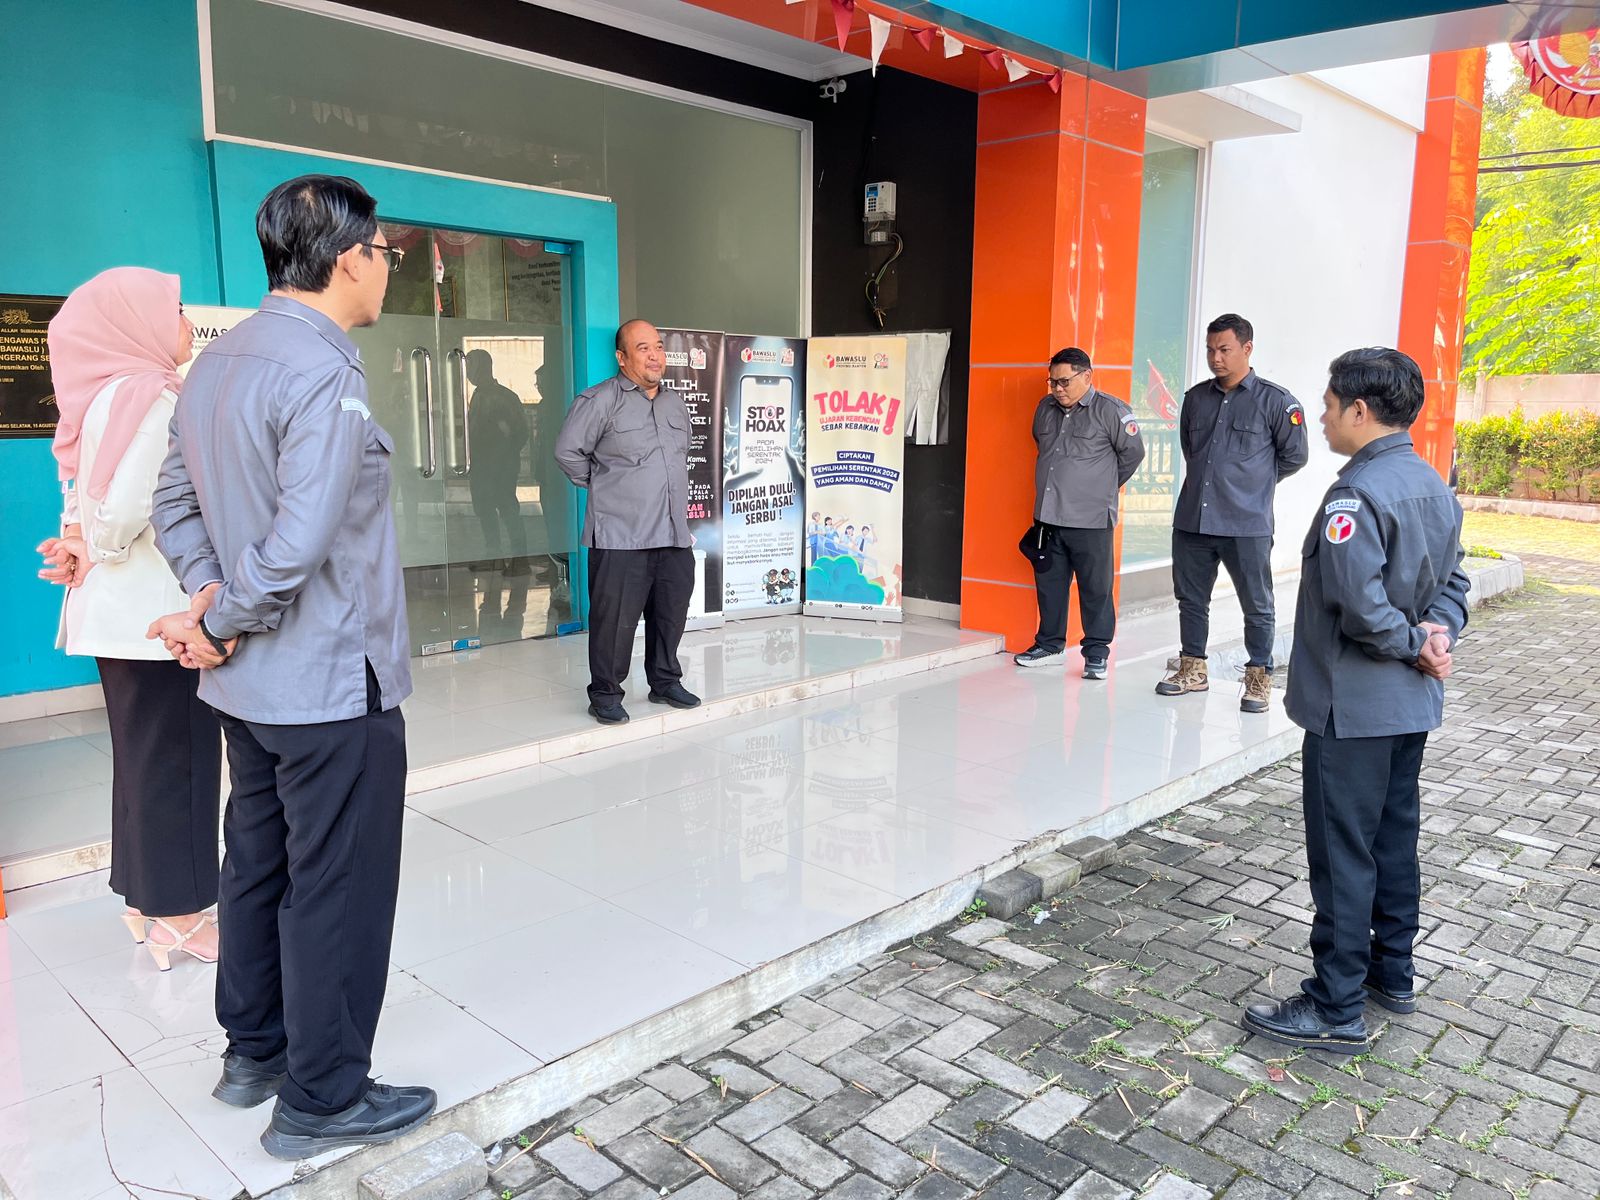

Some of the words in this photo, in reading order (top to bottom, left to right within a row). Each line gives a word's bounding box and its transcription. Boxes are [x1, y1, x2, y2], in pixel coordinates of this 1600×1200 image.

[747, 405, 785, 419] STOP
[745, 419, 786, 433] HOAX
[819, 415, 845, 424] UJARAN
[845, 415, 881, 425] KEBENCIAN
[820, 422, 843, 432] SEBAR
[844, 422, 880, 433] KEBAIKAN
[838, 452, 871, 460] CIPTAKAN
[813, 464, 848, 474] PEMILIHAN
[848, 464, 881, 475] SERENTAK
[882, 469, 898, 479] 2024
[816, 476, 834, 486] YANG
[855, 476, 868, 484] DAN
[869, 480, 891, 490] DAMAI
[728, 485, 766, 502] DIPILAH
[769, 481, 796, 496] DULU,
[731, 498, 769, 515] JANGAN
[772, 494, 794, 508] ASAL
[745, 510, 776, 525] SERBU
[779, 509, 782, 520] !
